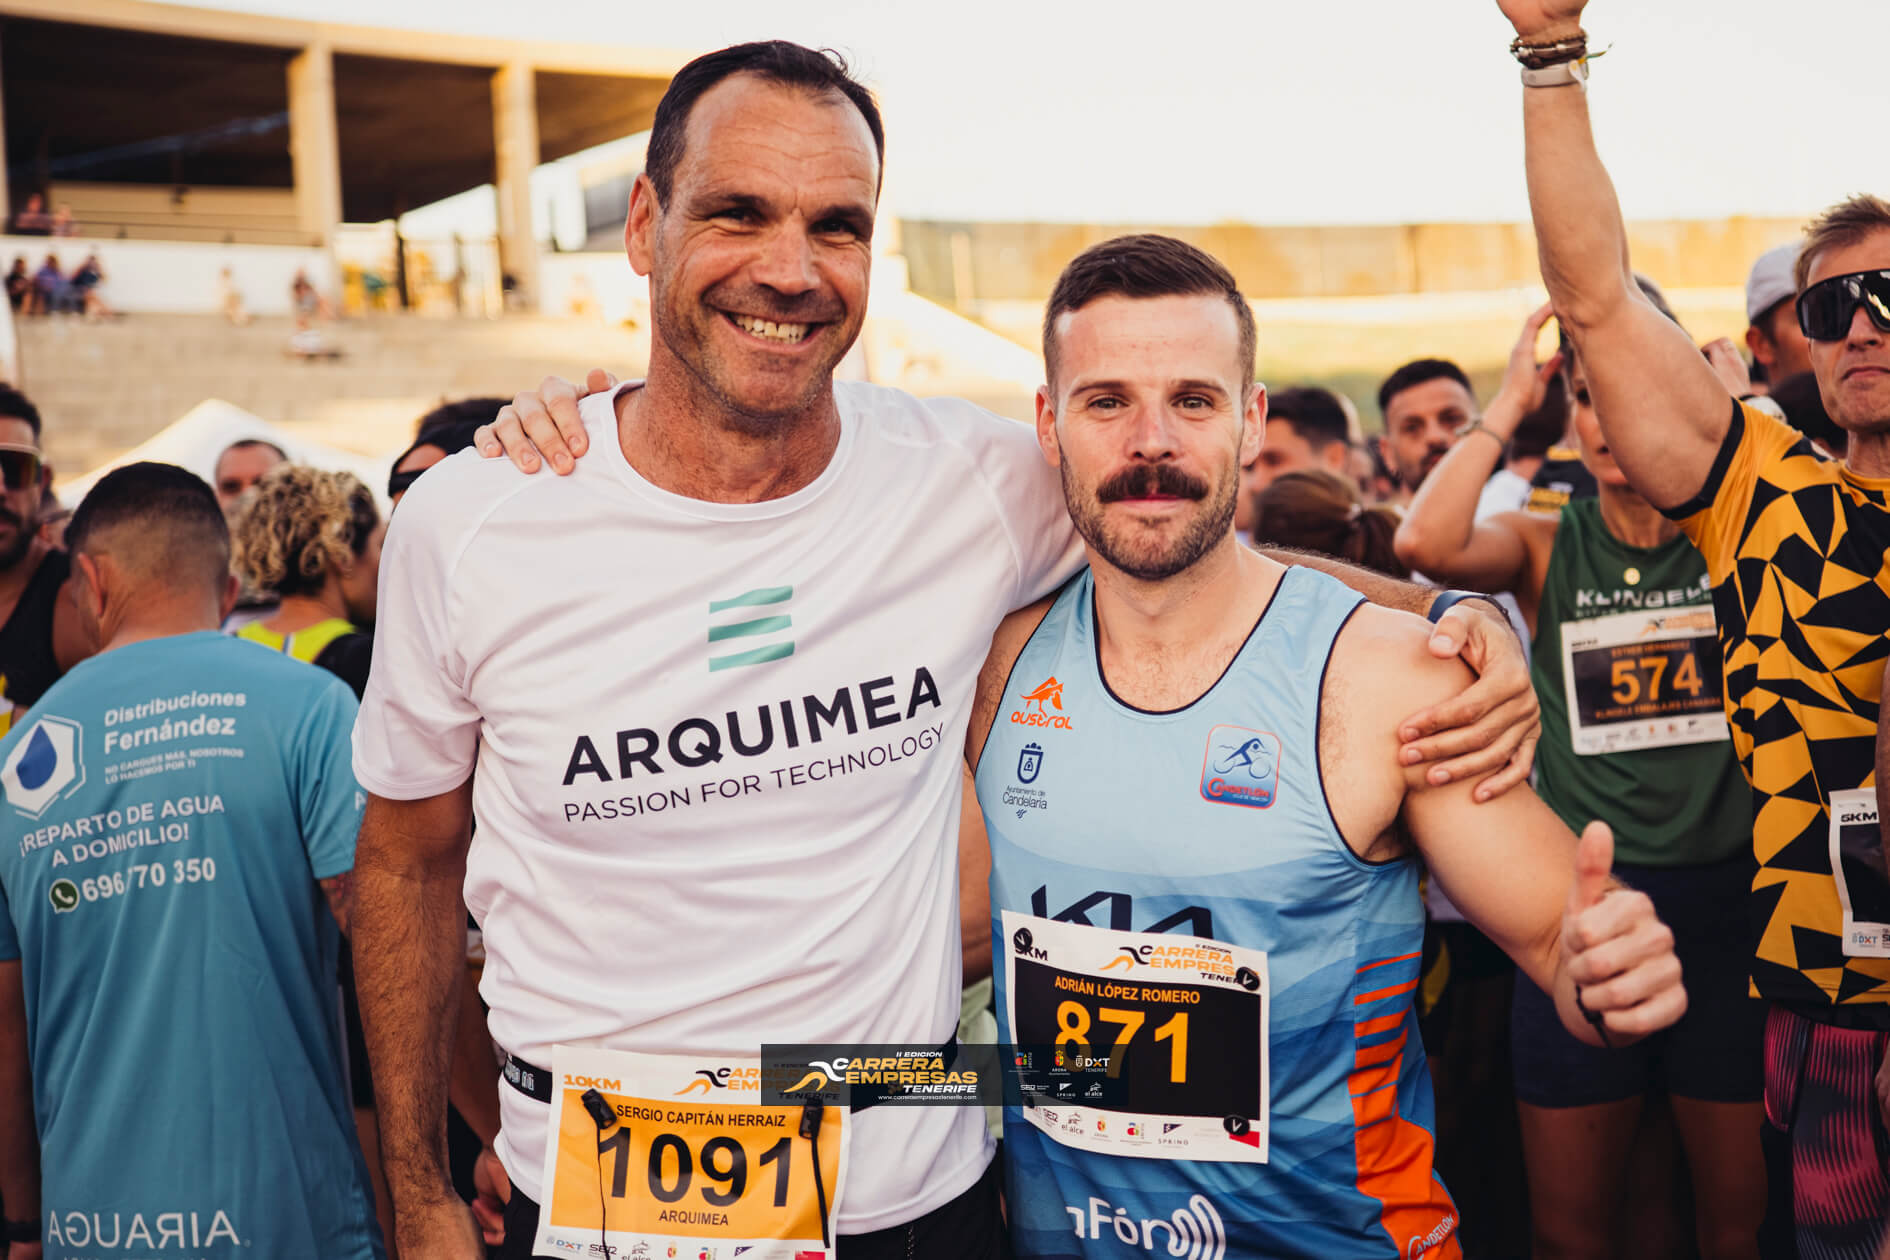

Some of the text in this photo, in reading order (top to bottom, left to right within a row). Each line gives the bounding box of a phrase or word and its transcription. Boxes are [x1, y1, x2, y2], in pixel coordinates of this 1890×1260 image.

[1611, 653, 1702, 704] 574
[104, 690, 246, 727] Distribuciones
[104, 713, 236, 754] Fernández
[562, 667, 942, 786] ARQUIMEA
[165, 760, 185, 771] POR
[189, 748, 244, 758] NOSOTROS
[565, 723, 944, 822] PASSION FOR TECHNOLOGY
[1003, 791, 1047, 809] Candelaria
[20, 795, 225, 857] ¡REPARTO DE AGUA
[1840, 812, 1878, 823] 5KM
[52, 823, 189, 867] A DOMICILIO!
[82, 872, 125, 901] 696
[173, 857, 216, 884] 350
[1140, 945, 1233, 965] CARRERA
[1150, 958, 1236, 976] EMPRES
[1055, 975, 1201, 1004] ADRIÁN LÓPEZ ROMERO
[1055, 1000, 1189, 1084] 871
[563, 1074, 621, 1091] 10KM
[617, 1105, 786, 1127] SERGIO CAPITÁN HERRAIZ
[1158, 1138, 1189, 1146] SPRING
[600, 1126, 792, 1208] 1091
[659, 1210, 729, 1226] ARQUIMEA
[556, 1240, 583, 1251] DXT
